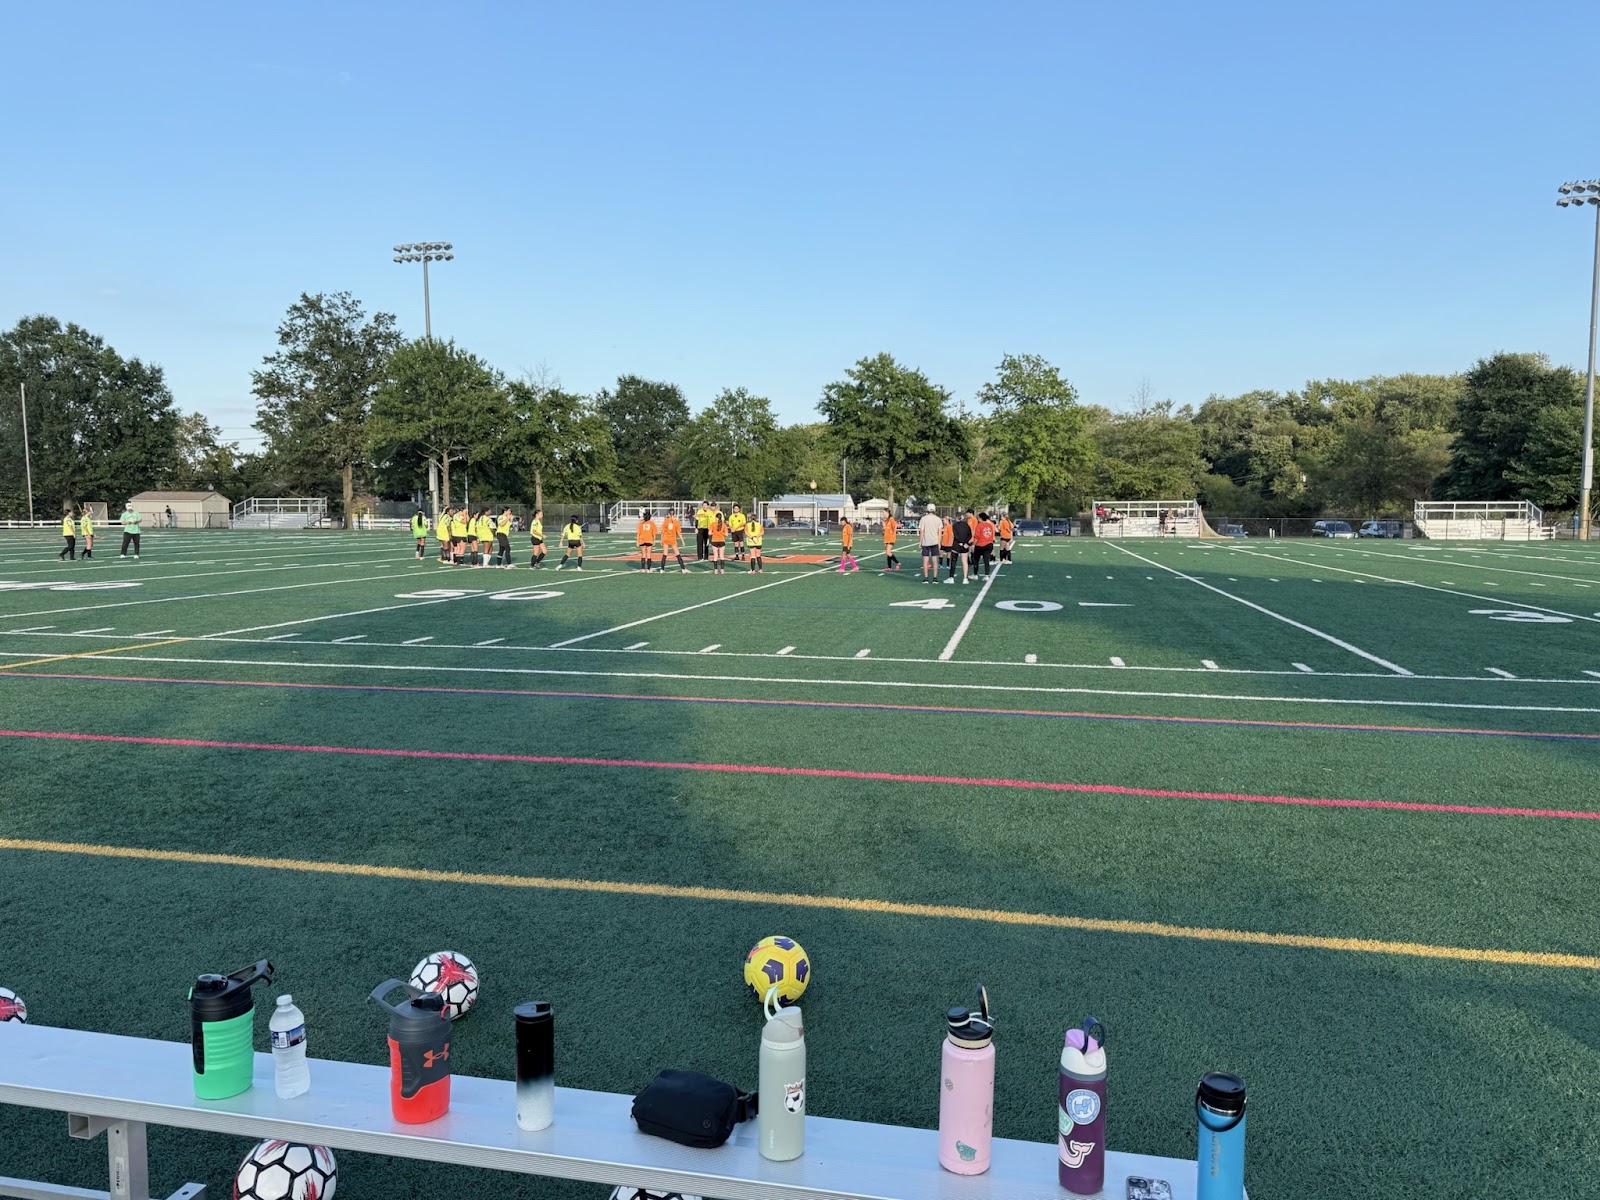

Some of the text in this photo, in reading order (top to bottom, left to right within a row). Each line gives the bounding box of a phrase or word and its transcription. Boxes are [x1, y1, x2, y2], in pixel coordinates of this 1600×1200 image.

[643, 523, 651, 531] 13
[394, 589, 565, 600] 50
[889, 598, 1064, 612] 40
